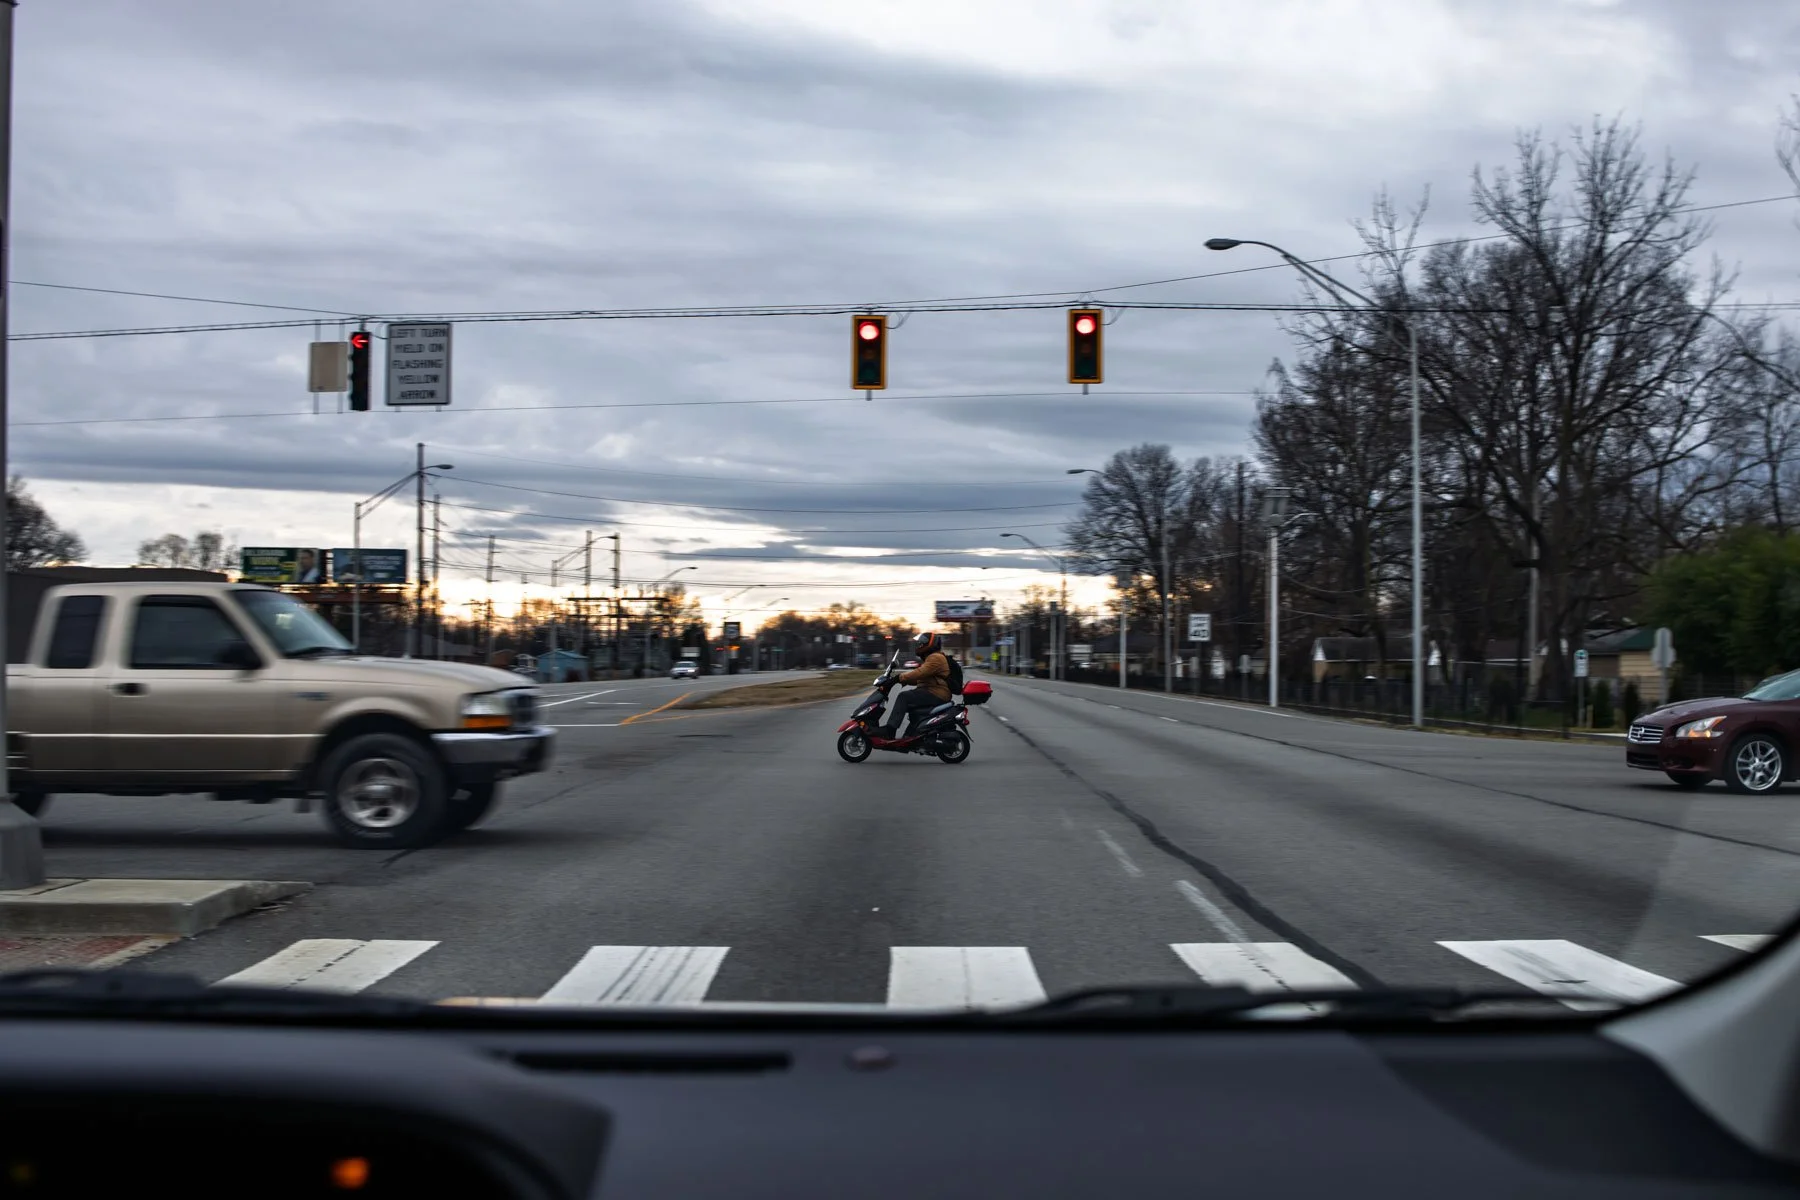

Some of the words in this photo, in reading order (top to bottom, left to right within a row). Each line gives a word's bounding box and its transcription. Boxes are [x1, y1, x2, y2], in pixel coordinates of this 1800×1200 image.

[391, 328, 416, 338] LEFT
[421, 328, 448, 338] TURN
[394, 344, 425, 353] YIELD
[428, 344, 445, 352] ON
[392, 360, 444, 369] FLASHING
[397, 375, 440, 384] YELLOW
[397, 390, 437, 399] ARROW
